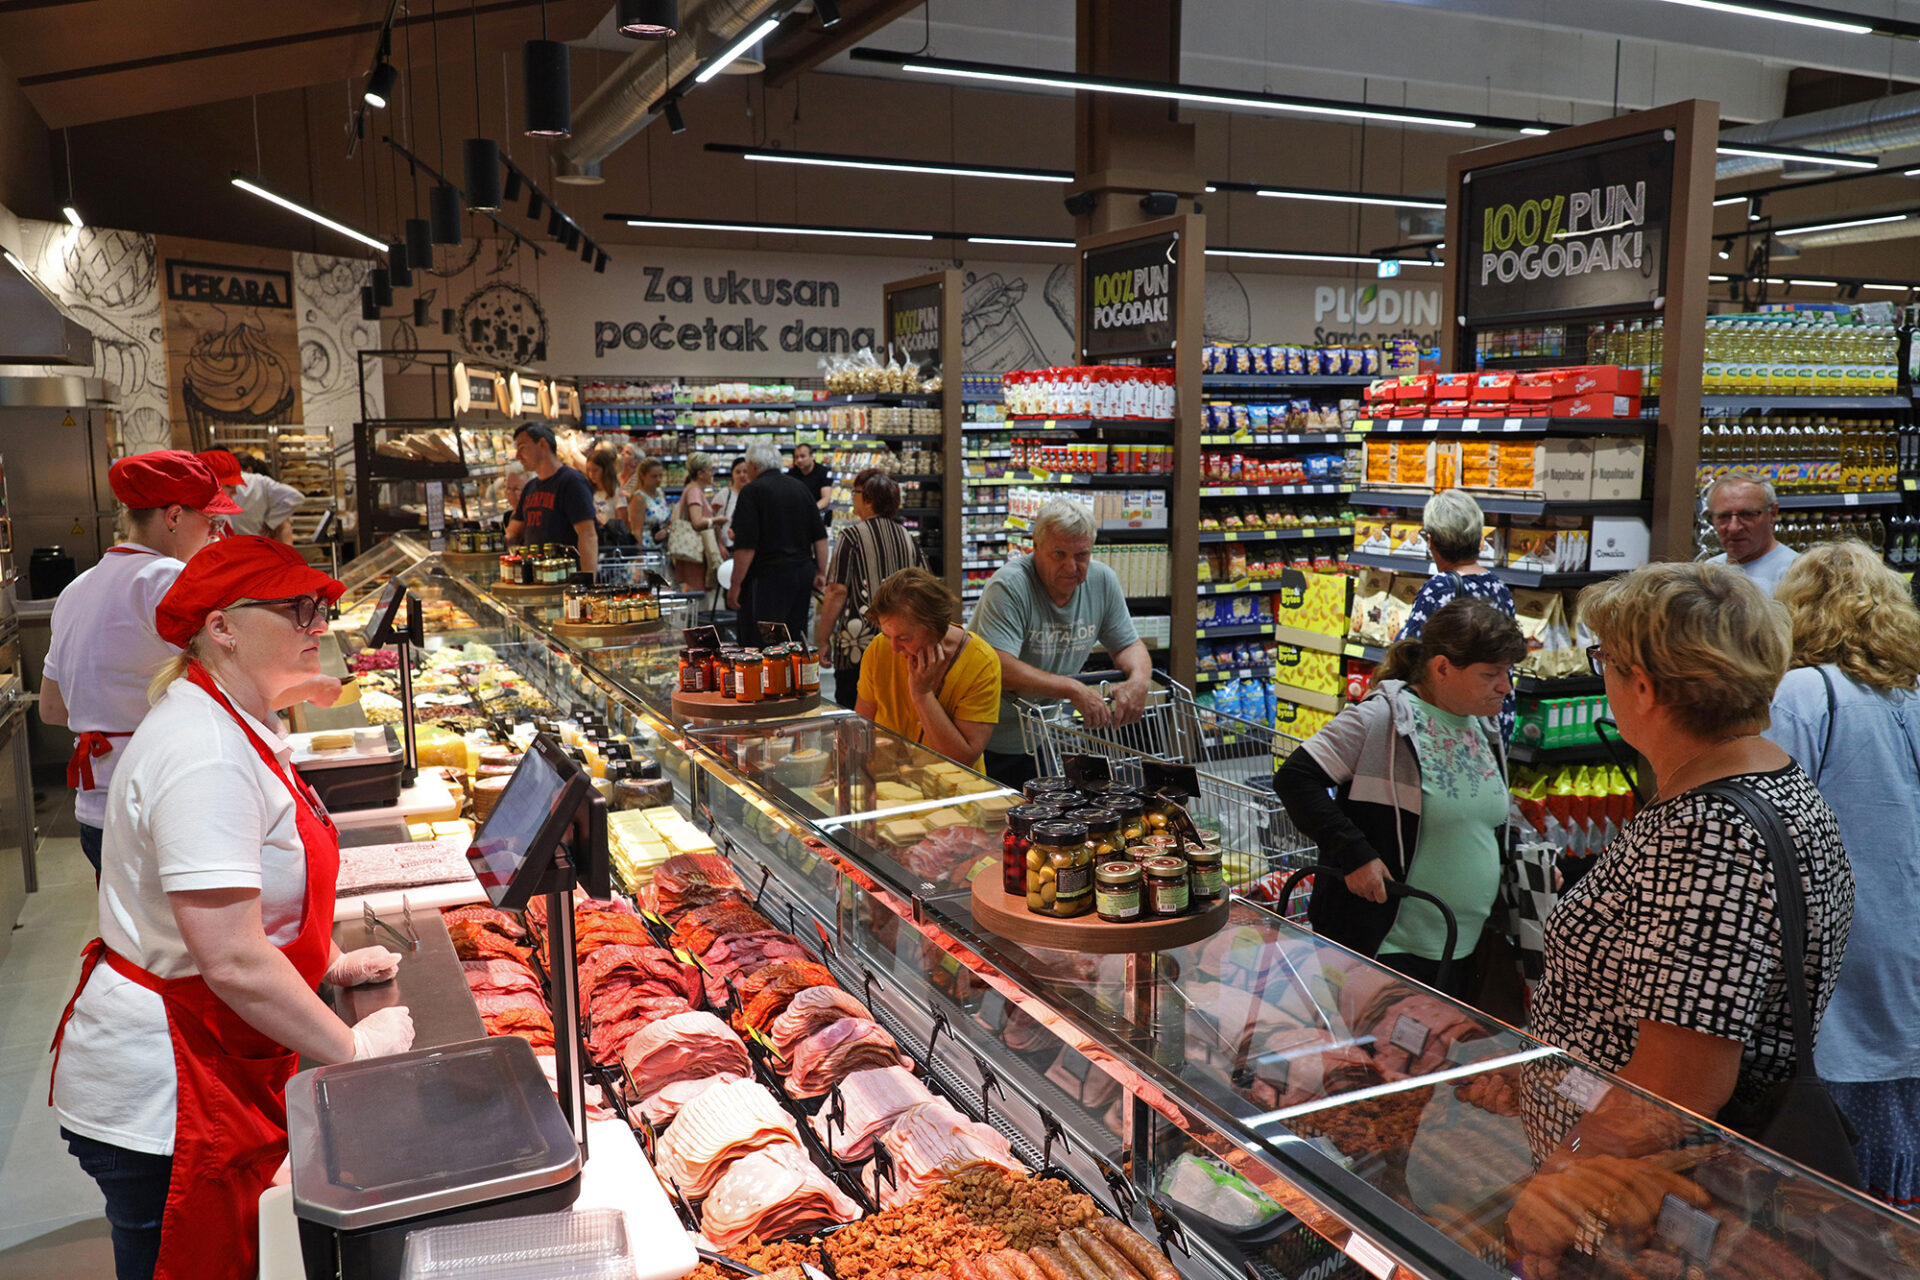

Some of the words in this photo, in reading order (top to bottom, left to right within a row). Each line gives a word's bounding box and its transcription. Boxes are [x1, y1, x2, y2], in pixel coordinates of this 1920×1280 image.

[1483, 195, 1567, 252] 100%
[1568, 181, 1646, 233] PUN
[1481, 231, 1643, 286] POGODAK!
[181, 272, 281, 303] PEKARA
[643, 267, 693, 303] Za
[704, 270, 840, 307] ukusan
[1094, 270, 1134, 306] 100%
[1134, 264, 1169, 298] PUN
[1314, 286, 1442, 325] PLODIN
[1094, 297, 1168, 329] POGODAK!
[594, 315, 768, 357] početak
[780, 319, 884, 353] dana.
